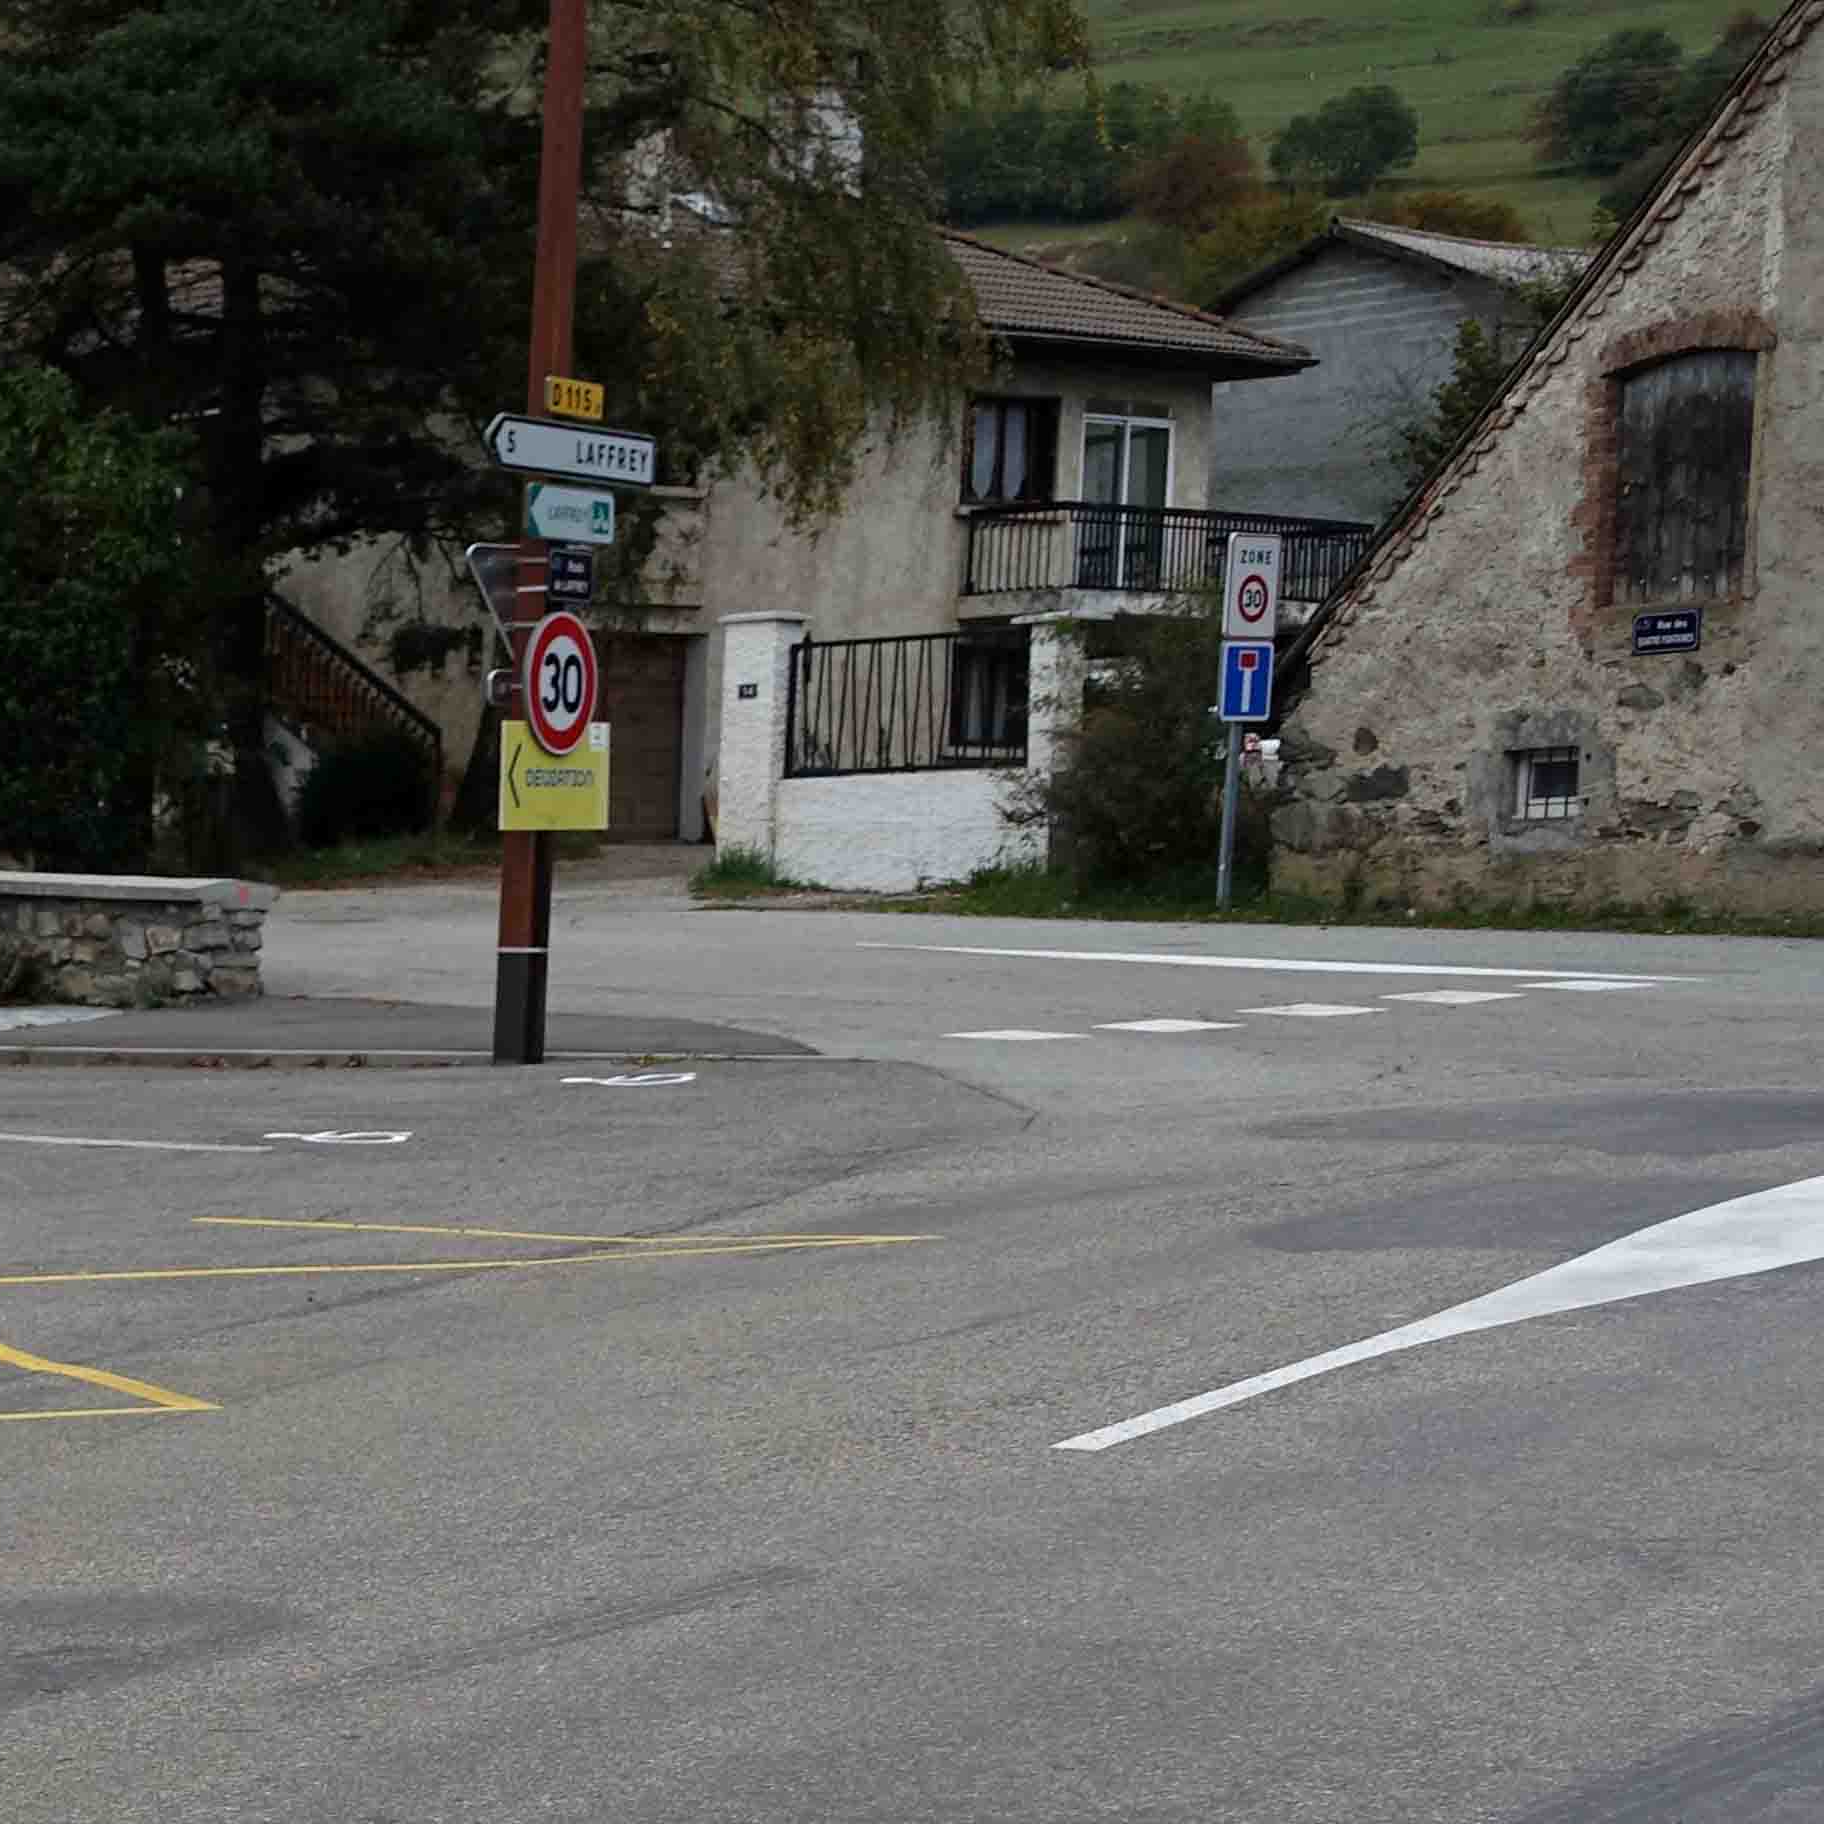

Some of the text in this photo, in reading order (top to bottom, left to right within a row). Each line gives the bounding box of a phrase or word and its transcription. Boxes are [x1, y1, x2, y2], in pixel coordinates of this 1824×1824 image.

[575, 439, 649, 473] LAFFREY
[1240, 549, 1273, 565] ZONE
[1244, 588, 1262, 608] 30
[542, 652, 582, 714] 30
